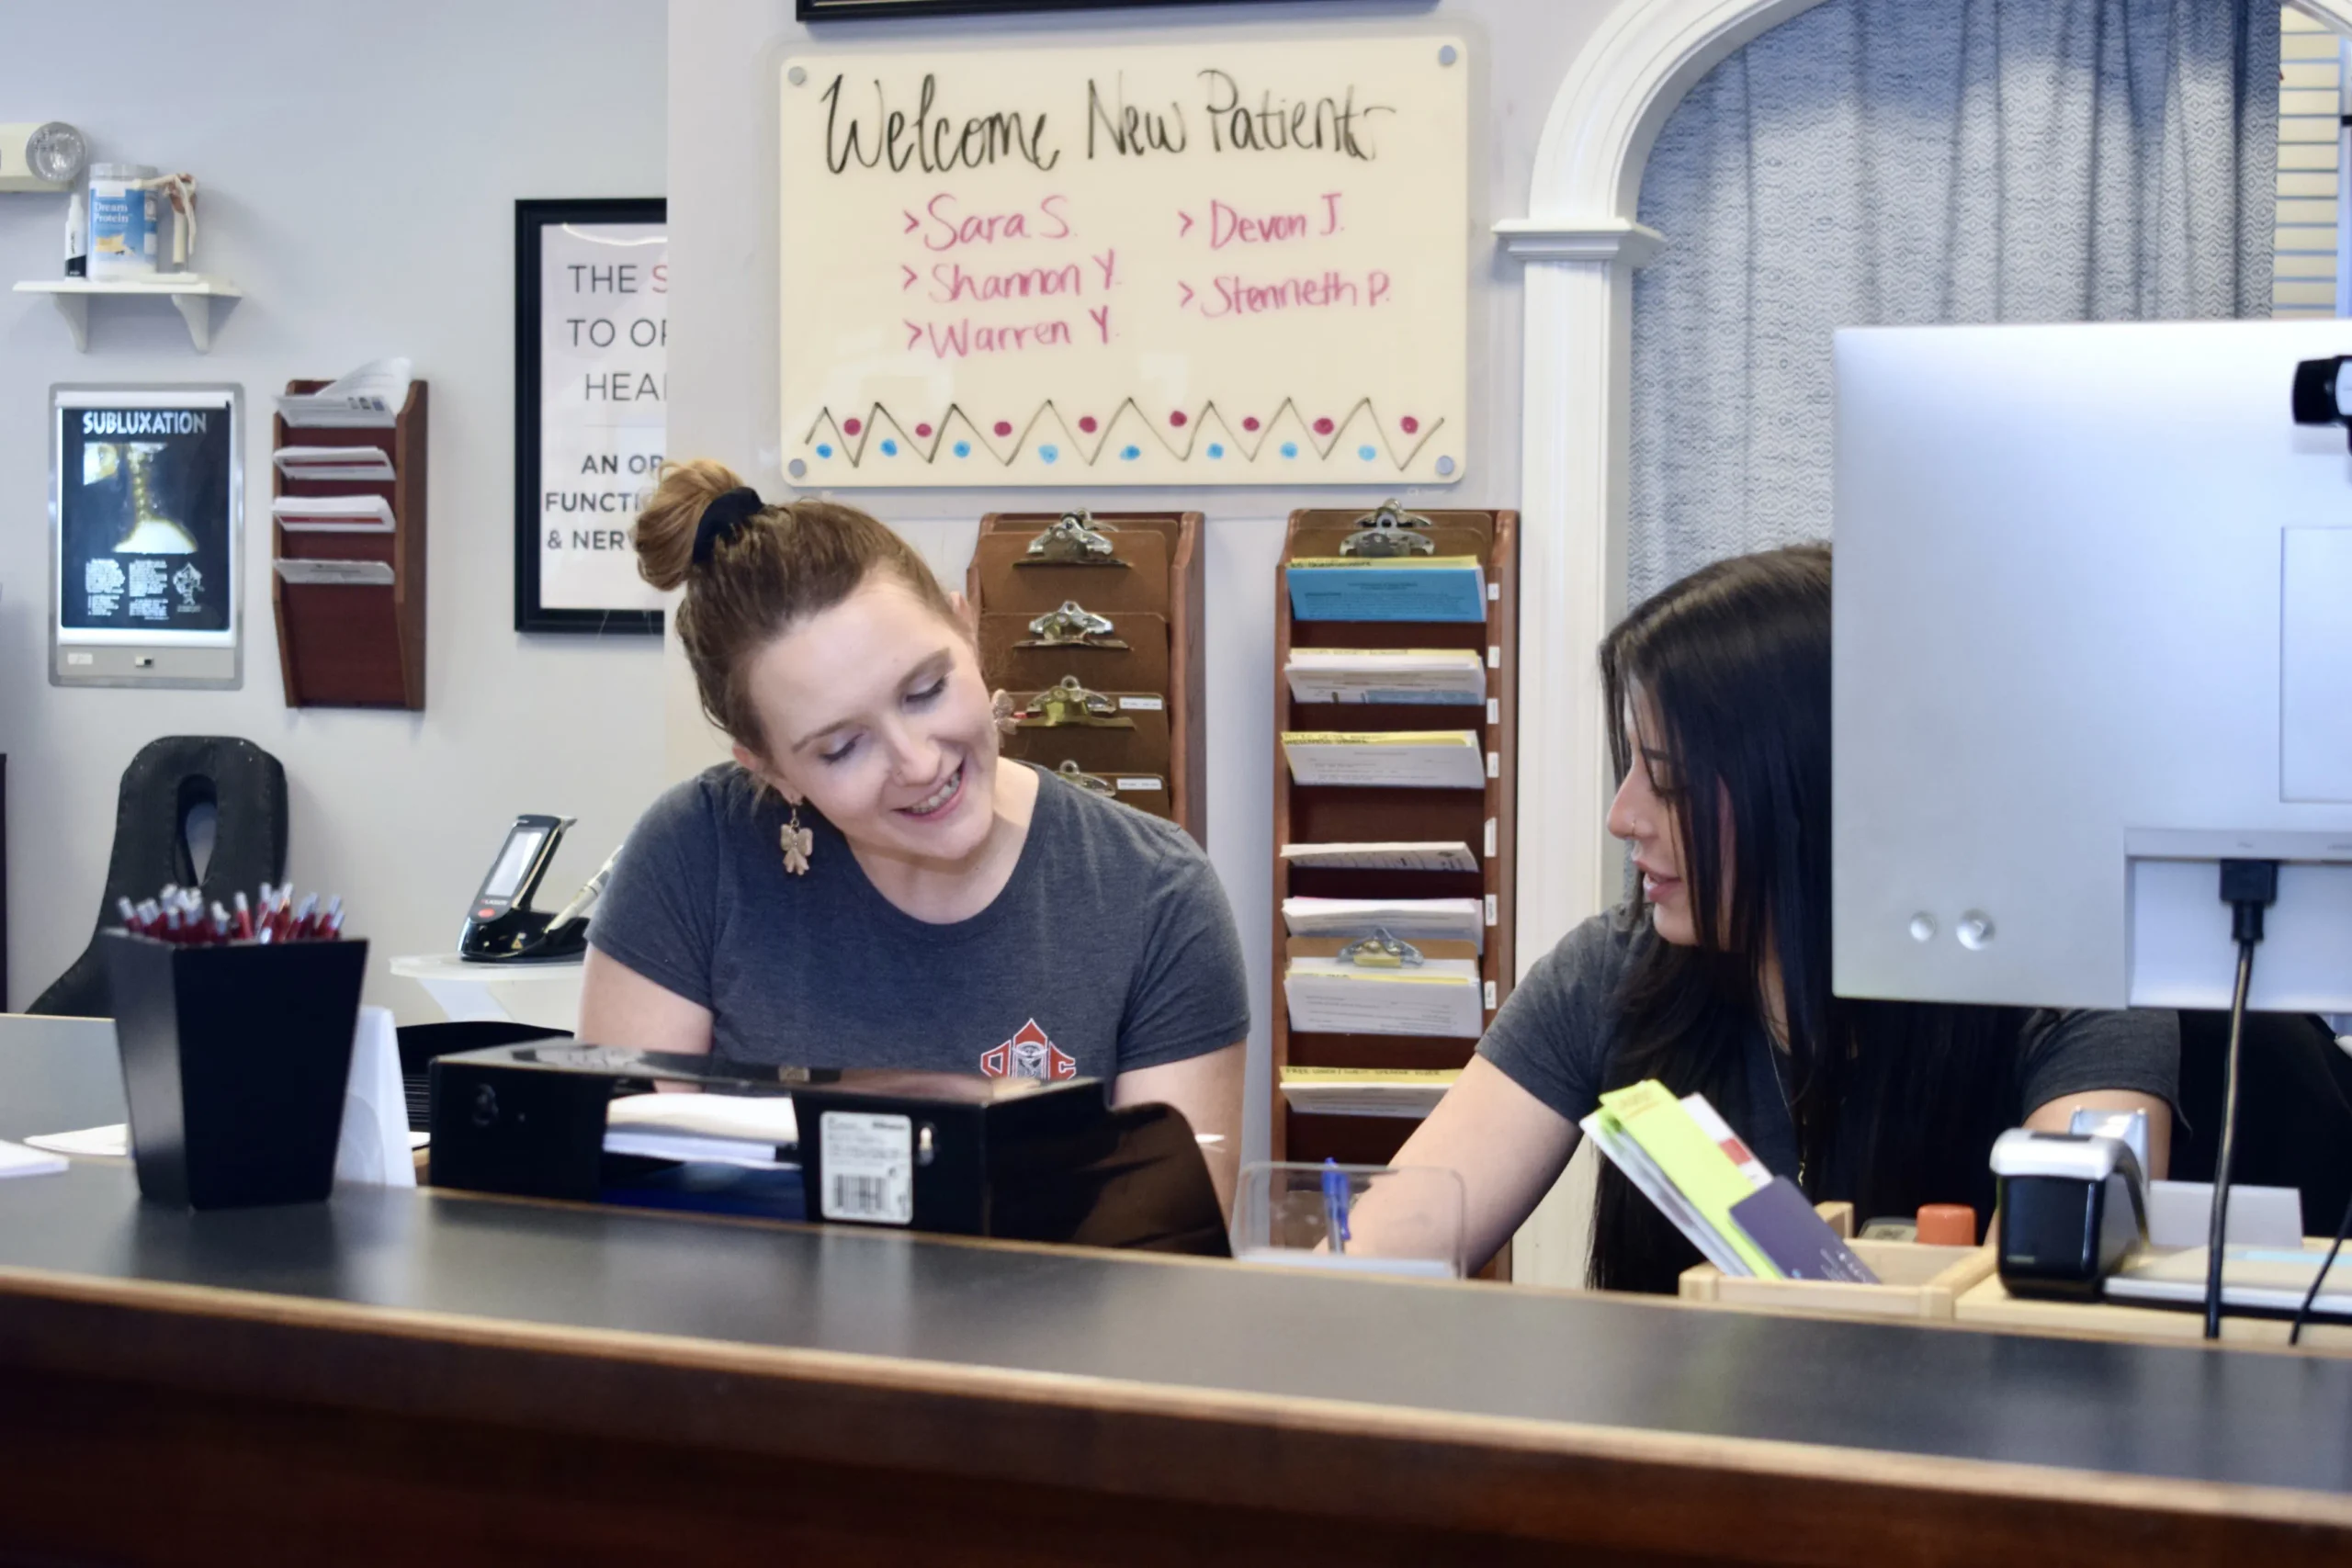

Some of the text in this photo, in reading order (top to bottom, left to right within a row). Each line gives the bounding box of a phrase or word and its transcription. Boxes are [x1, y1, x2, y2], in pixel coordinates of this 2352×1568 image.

[820, 73, 1060, 175] Welcome
[1088, 69, 1187, 160] New
[94, 202, 129, 212] Dream
[94, 212, 130, 223] Protein
[923, 193, 1032, 252] Sara
[567, 265, 638, 294] THE
[566, 319, 616, 347] TO
[928, 318, 1072, 359] Warren
[585, 372, 667, 401] HEA
[82, 411, 207, 434] SUBLUXATION
[581, 455, 618, 474] AN
[547, 529, 562, 550] &
